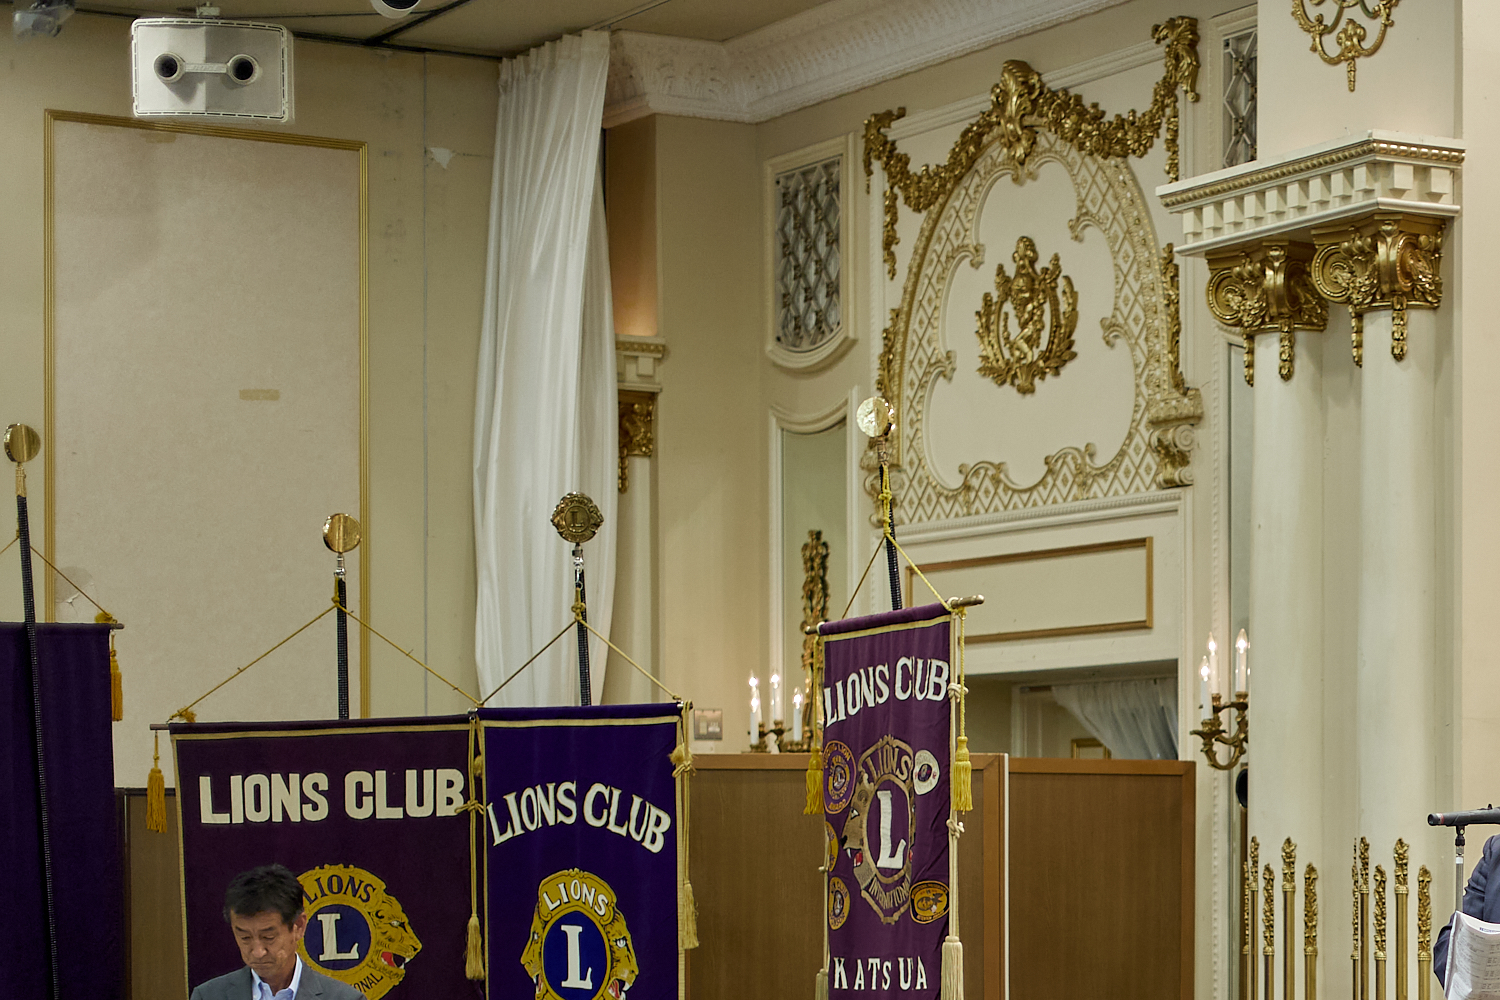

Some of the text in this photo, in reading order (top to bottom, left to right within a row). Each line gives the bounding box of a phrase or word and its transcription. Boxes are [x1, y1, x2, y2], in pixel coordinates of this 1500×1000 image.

[824, 662, 890, 728] LIONS
[865, 745, 912, 781] LIONS
[199, 768, 465, 824] LIONS CLUB
[486, 780, 671, 854] LIONS CLUB
[876, 790, 907, 869] L
[302, 874, 377, 905] LIONS
[542, 879, 609, 916] LIONS
[317, 913, 360, 962] L
[560, 924, 593, 990] L
